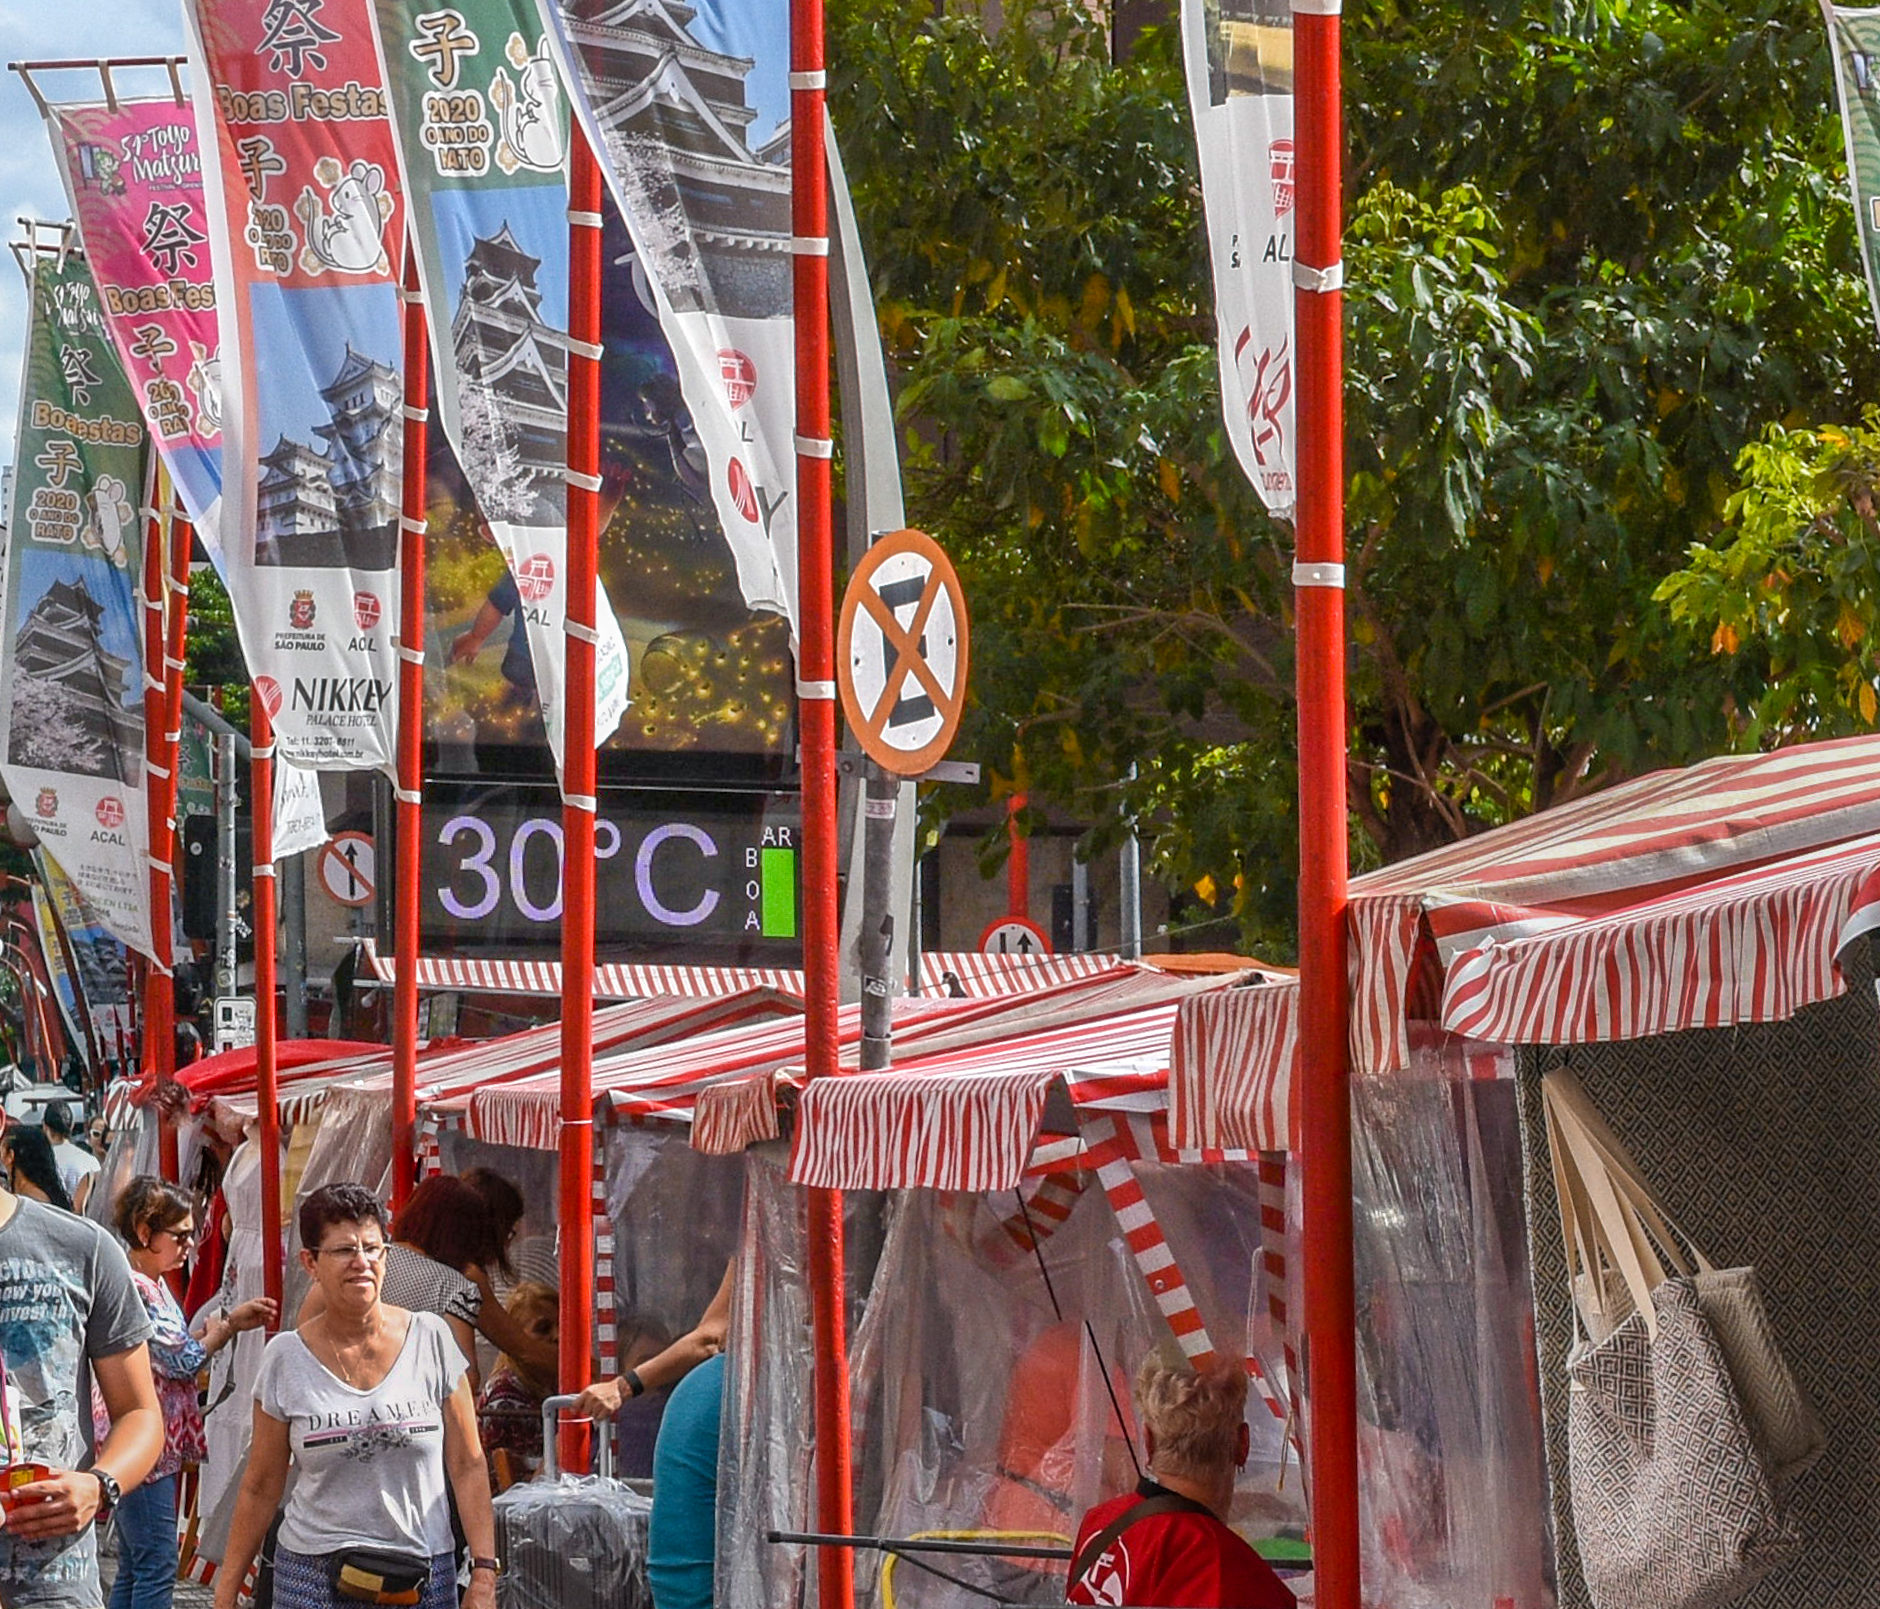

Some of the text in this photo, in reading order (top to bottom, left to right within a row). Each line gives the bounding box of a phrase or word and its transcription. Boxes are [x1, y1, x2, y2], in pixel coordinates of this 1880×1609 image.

[412, 13, 476, 84] 子
[427, 95, 480, 123] 2020
[149, 123, 192, 157] Toyo
[425, 126, 438, 145] O
[467, 124, 489, 143] DO
[132, 149, 202, 186] Matsur
[240, 139, 284, 200] 子
[141, 202, 207, 274] 祭
[108, 286, 167, 316] Boas
[132, 327, 176, 374] 子
[36, 442, 83, 487] 子
[35, 492, 77, 510] 2020
[64, 511, 79, 524] DO
[35, 522, 73, 541] RATO
[274, 638, 326, 651] SÃO PAULO
[275, 632, 326, 641] PREFEITURA DE
[292, 677, 393, 713] NIKKEY
[306, 713, 346, 726] PALACE
[41, 826, 68, 837] PAULO
[91, 830, 126, 846] ACAL
[761, 826, 793, 847] AR
[34, 1283, 64, 1303] you
